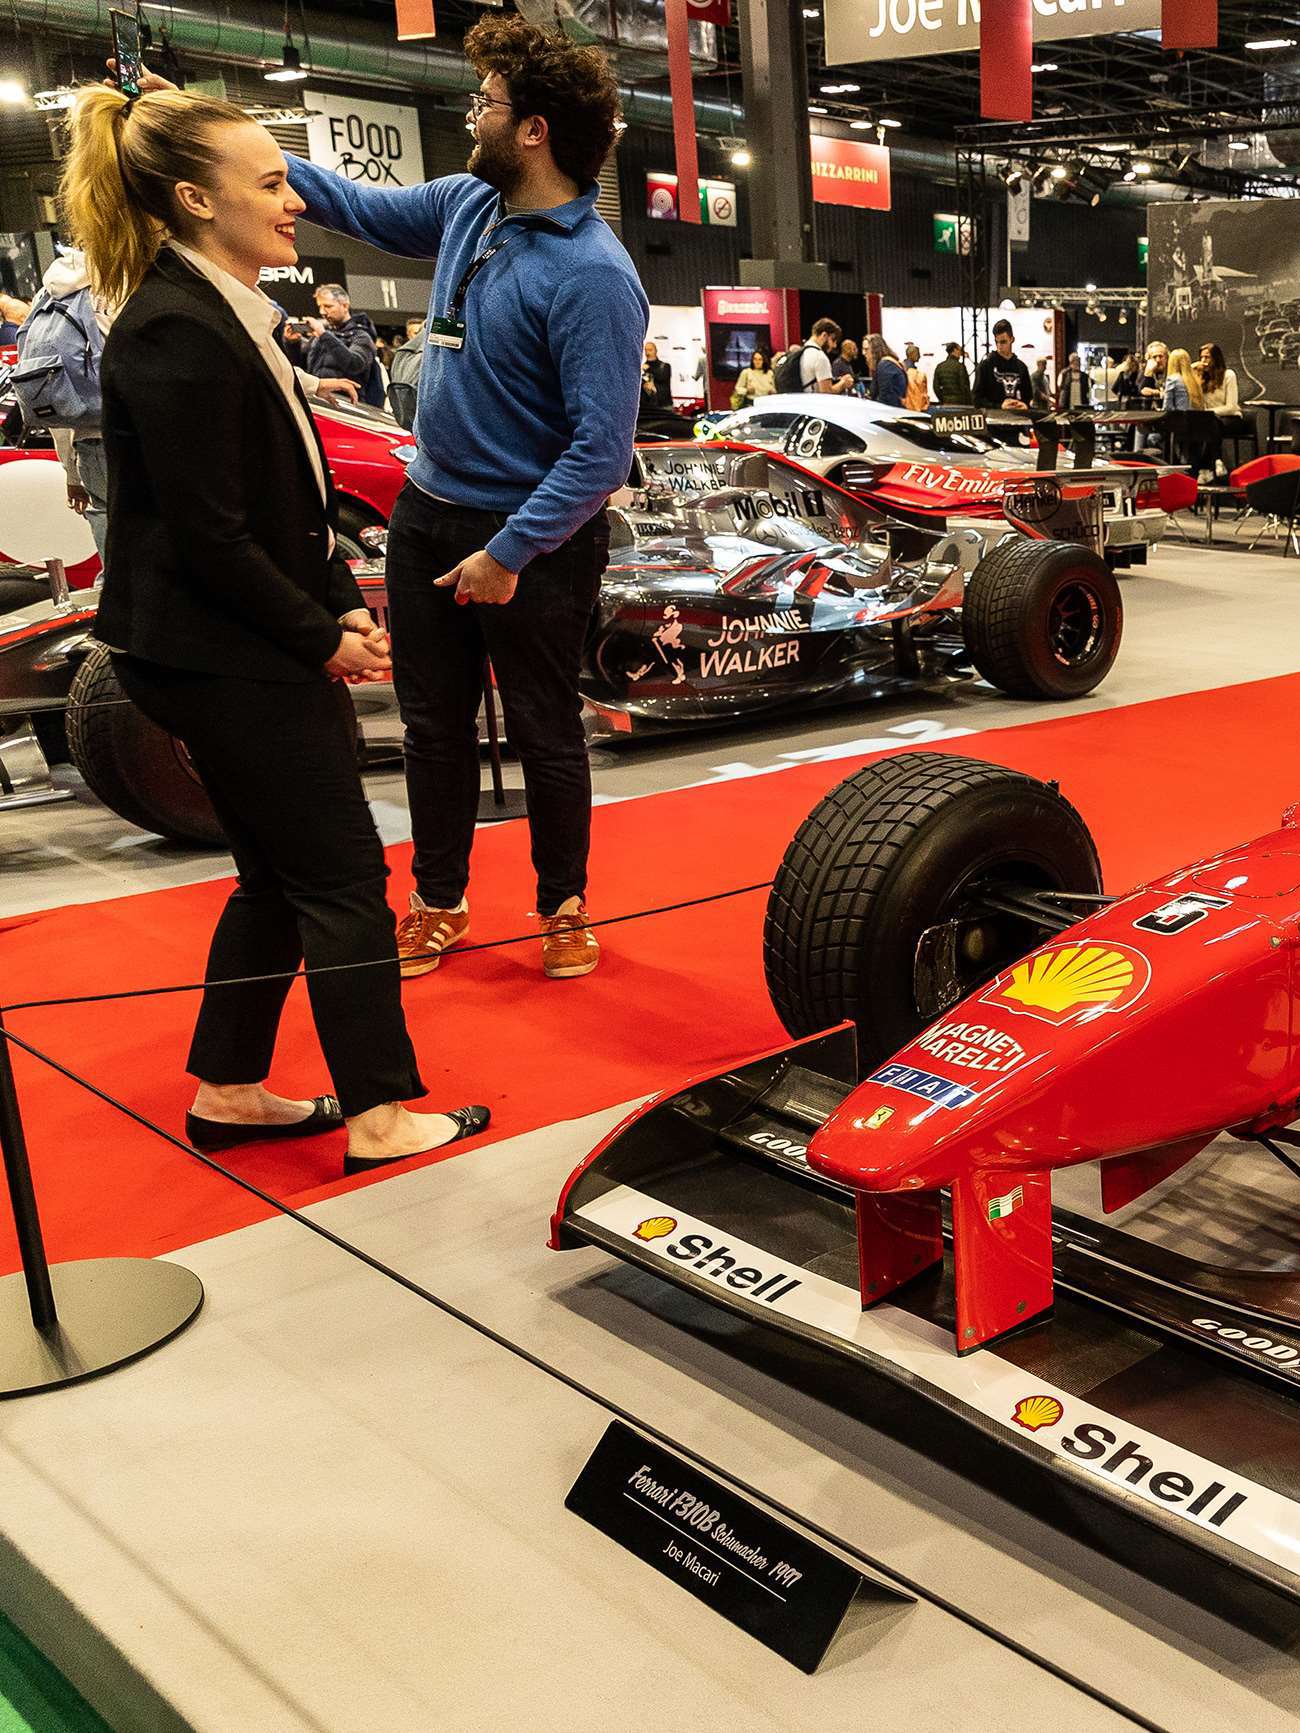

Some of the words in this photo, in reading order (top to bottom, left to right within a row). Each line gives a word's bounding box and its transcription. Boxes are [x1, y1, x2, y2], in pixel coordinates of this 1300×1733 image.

[329, 114, 403, 161] FOOD
[935, 413, 970, 433] Mobil
[902, 464, 943, 489] Fly
[733, 491, 801, 521] Mobil
[707, 609, 809, 648] JOHNNIE
[700, 639, 801, 679] WALKER
[877, 1066, 969, 1104] FIAT
[748, 1132, 807, 1162] GOO
[666, 1234, 803, 1304] Shell
[1061, 1423, 1248, 1527] Shell
[627, 1464, 679, 1508] Ferrari
[668, 1491, 721, 1533] F310B
[711, 1523, 769, 1570] Schumacher
[768, 1560, 803, 1588] 1997
[662, 1540, 684, 1562] Joe
[681, 1551, 722, 1587] Macari
